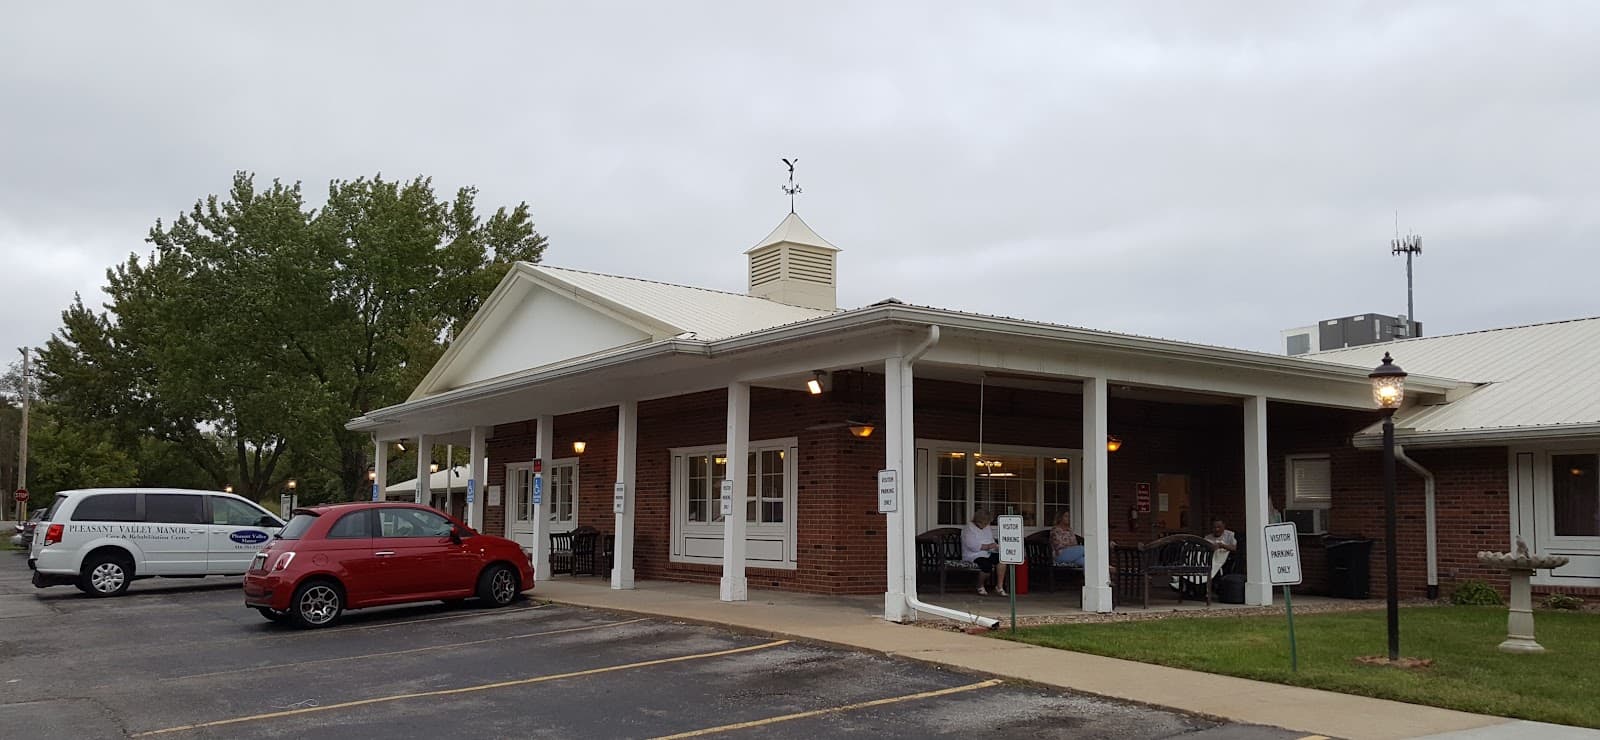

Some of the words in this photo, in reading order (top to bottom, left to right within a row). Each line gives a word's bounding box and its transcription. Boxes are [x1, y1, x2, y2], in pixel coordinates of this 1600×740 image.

[69, 524, 114, 533] PLEASANT
[119, 525, 152, 533] VALLEY
[156, 526, 188, 534] MANOR
[1270, 533, 1291, 542] VISITOR
[1270, 549, 1294, 558] PARKING
[1277, 565, 1291, 574] ONLY
